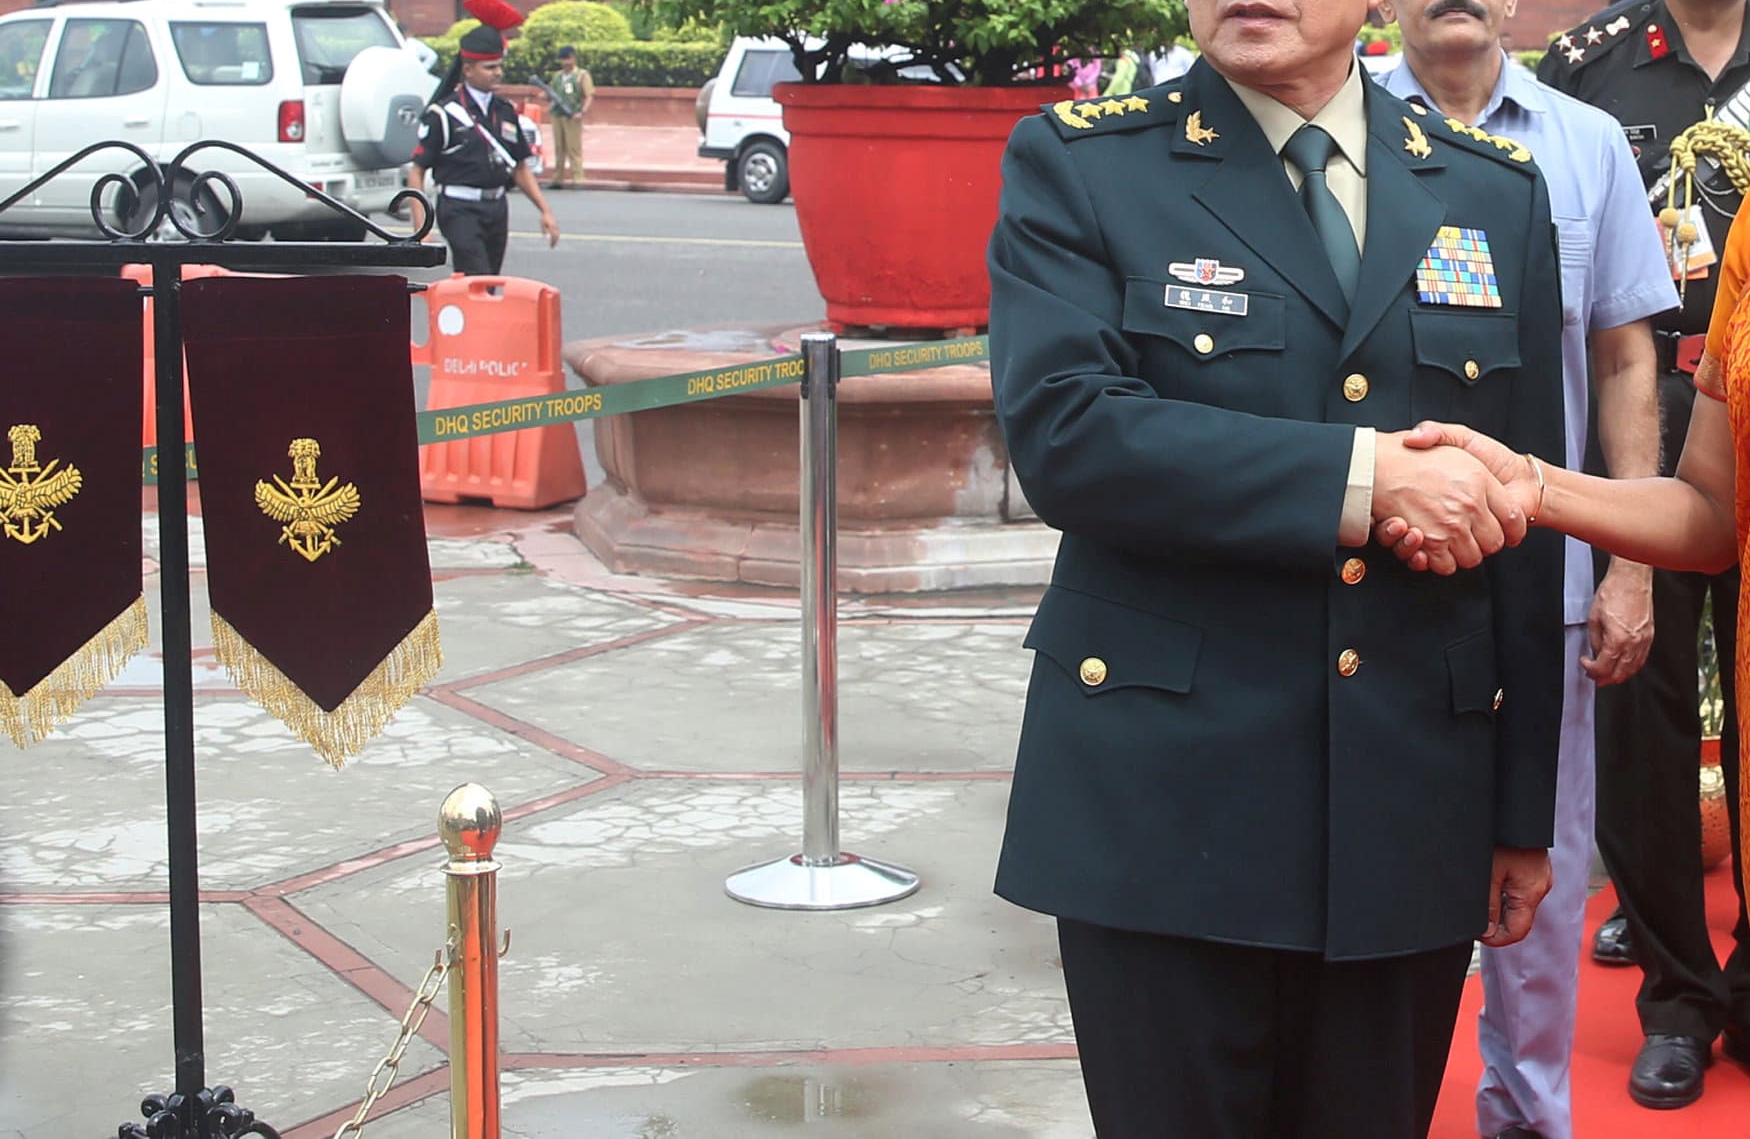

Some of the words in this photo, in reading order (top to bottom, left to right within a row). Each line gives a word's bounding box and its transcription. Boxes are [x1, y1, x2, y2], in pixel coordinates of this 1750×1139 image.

[869, 352, 892, 369] DHQ
[894, 346, 942, 366] SECURITY
[944, 341, 983, 360] TROOPS
[687, 376, 714, 395] DHQ
[716, 364, 772, 390] SECURITY
[435, 414, 468, 436] DHQ
[472, 402, 543, 431] SECURITY
[546, 393, 602, 418] TROOPS
